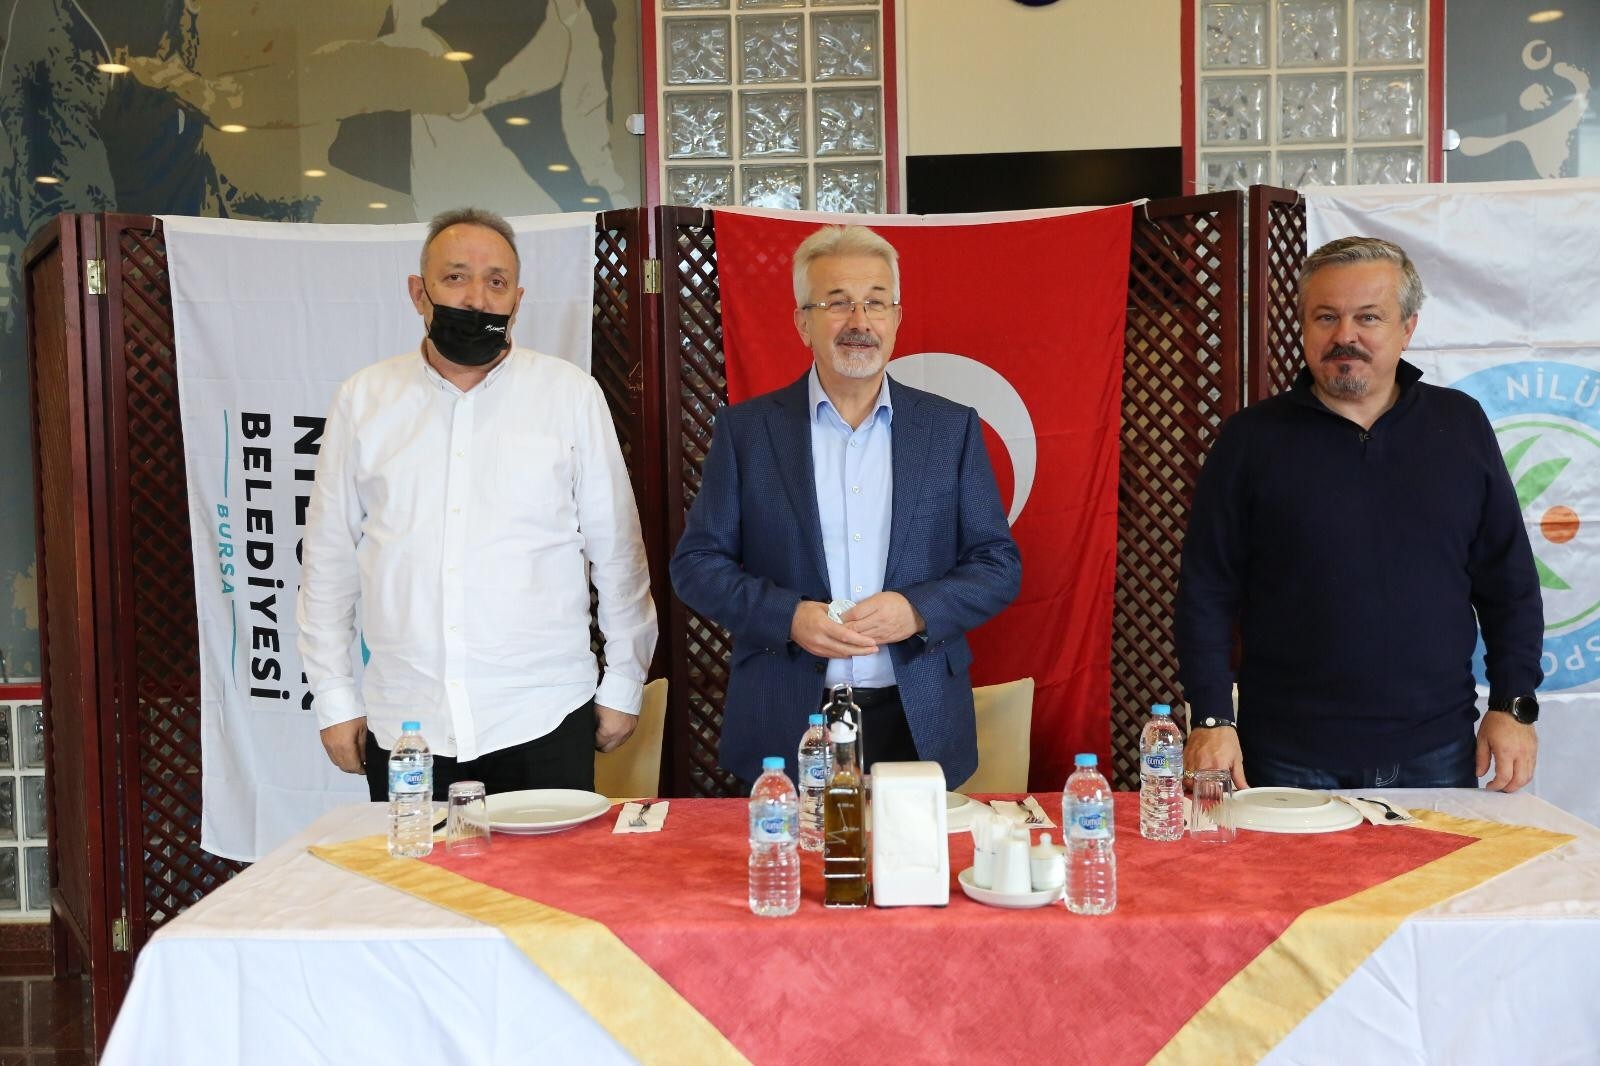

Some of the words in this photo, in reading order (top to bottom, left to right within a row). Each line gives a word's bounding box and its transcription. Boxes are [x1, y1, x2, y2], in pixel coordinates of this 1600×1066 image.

[1506, 367, 1600, 408] NİLÜ
[217, 504, 235, 593] BURSA
[241, 412, 290, 700] BELEDİYESİ
